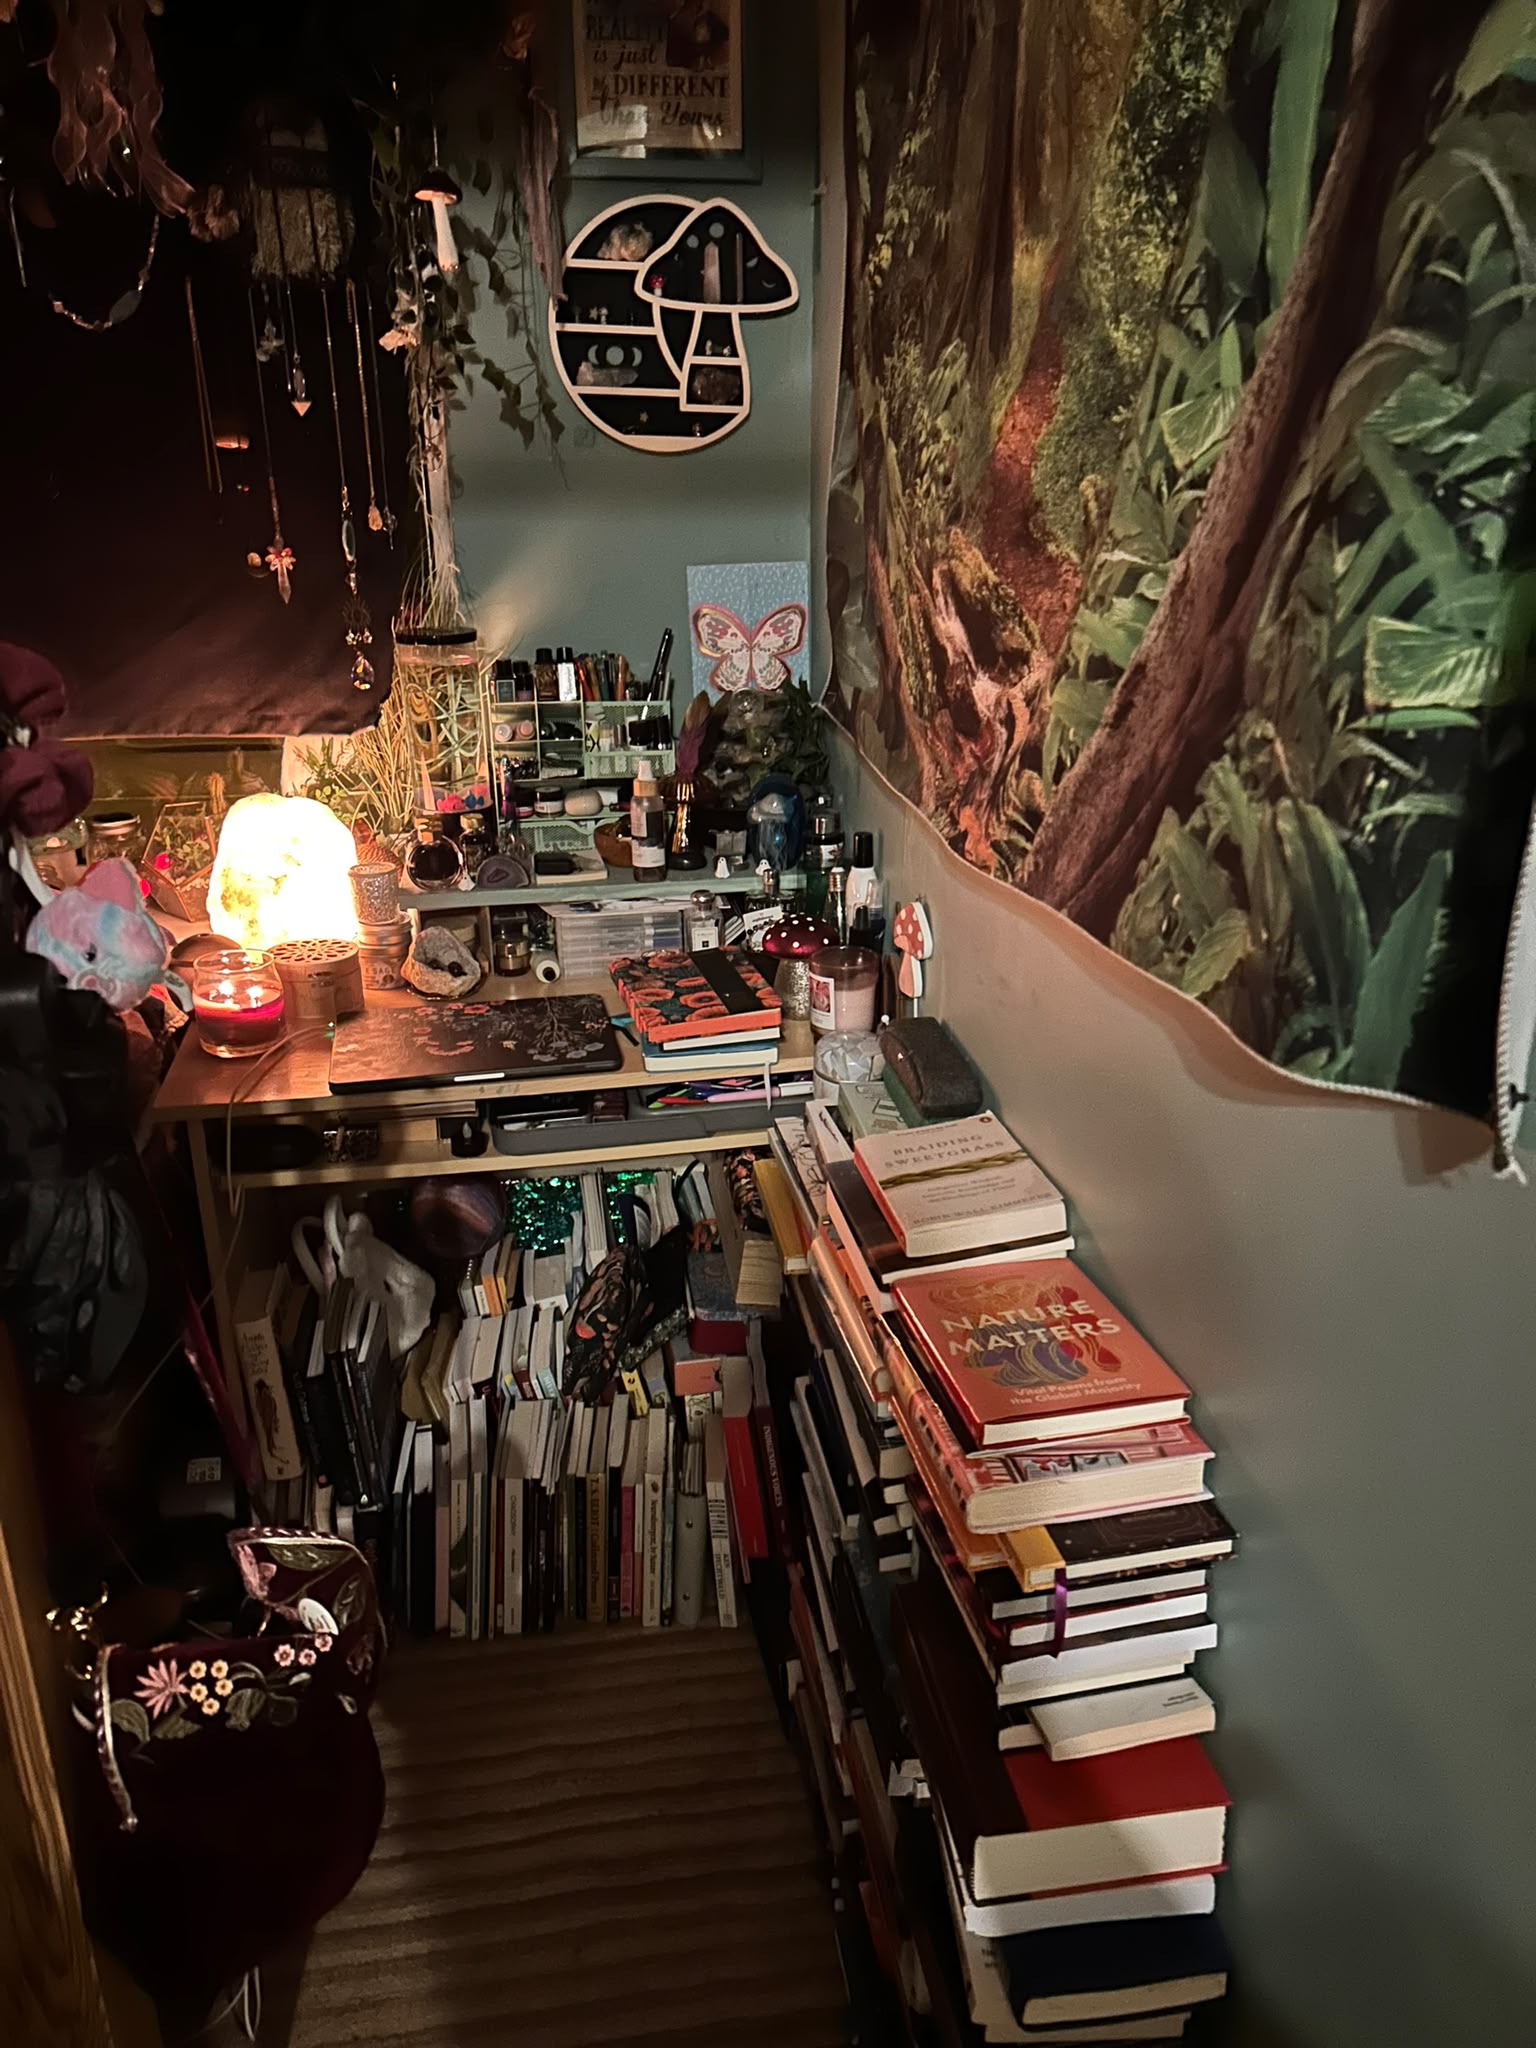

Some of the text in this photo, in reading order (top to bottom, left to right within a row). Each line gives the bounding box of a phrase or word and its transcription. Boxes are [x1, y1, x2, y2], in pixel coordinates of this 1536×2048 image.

[613, 43, 657, 71] just
[614, 74, 729, 98] DIFFERENT
[660, 101, 724, 127] Yours
[884, 1140, 1005, 1169] SWEETGRASS
[893, 1134, 982, 1156] BRAIDING
[940, 1300, 1096, 1333] NATURE
[949, 1318, 1121, 1356] MATTERS
[1010, 1383, 1141, 1405] the Global Majority
[1015, 1378, 1127, 1396] Vital Poems from
[590, 1498, 600, 1526] ELIOT
